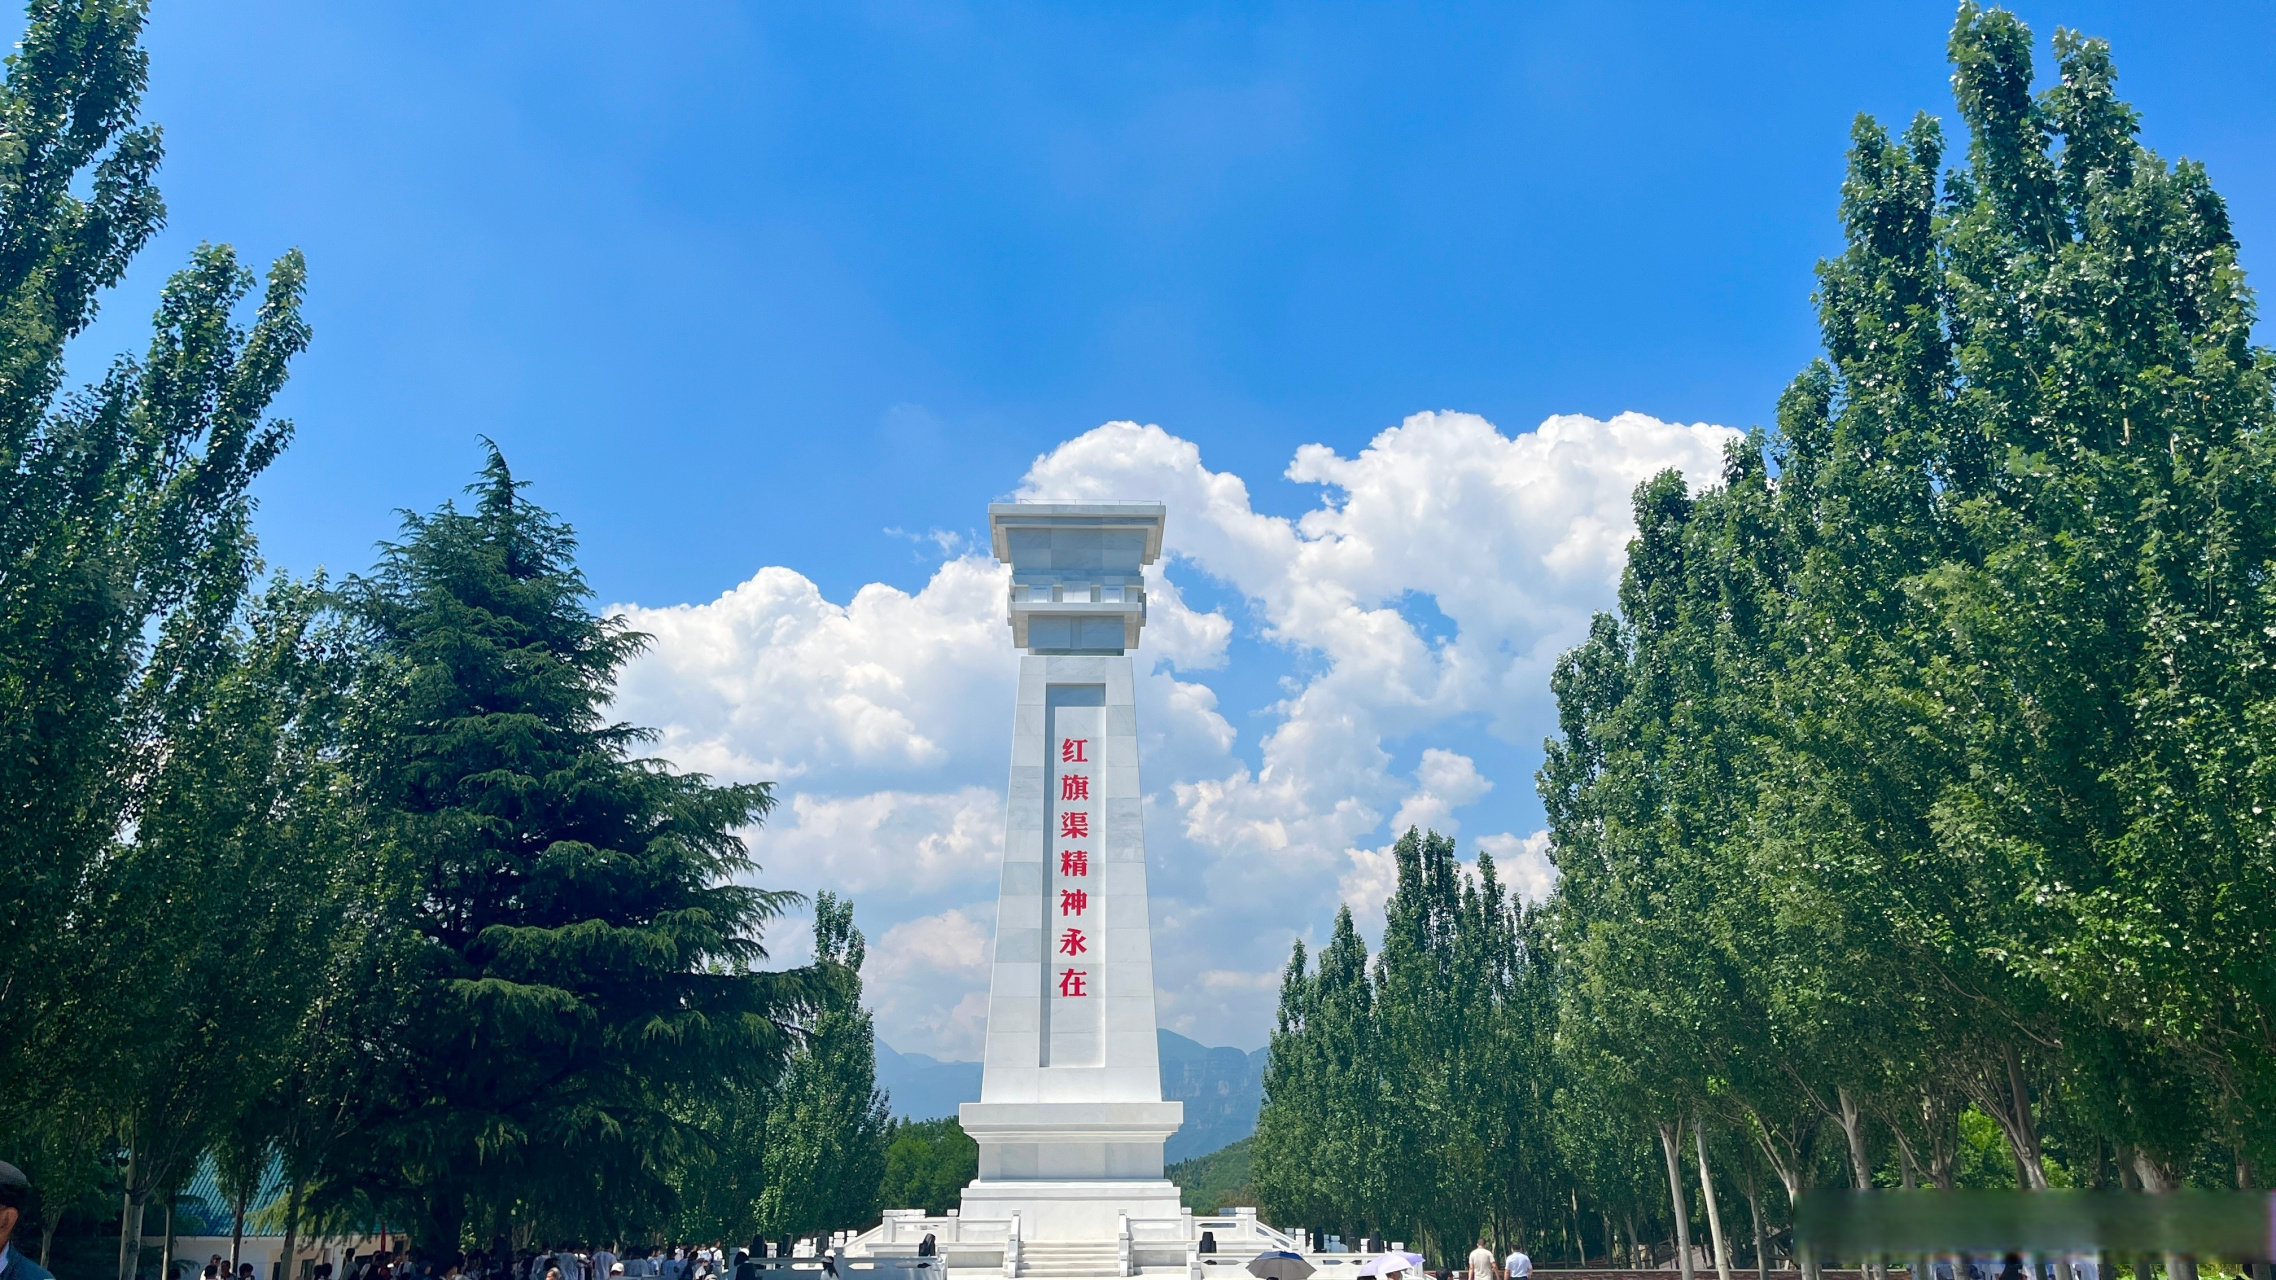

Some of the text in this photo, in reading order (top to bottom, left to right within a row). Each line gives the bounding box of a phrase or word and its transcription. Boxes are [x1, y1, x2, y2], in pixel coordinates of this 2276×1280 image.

[1058, 738, 1089, 997] 红旗渠精神永在
